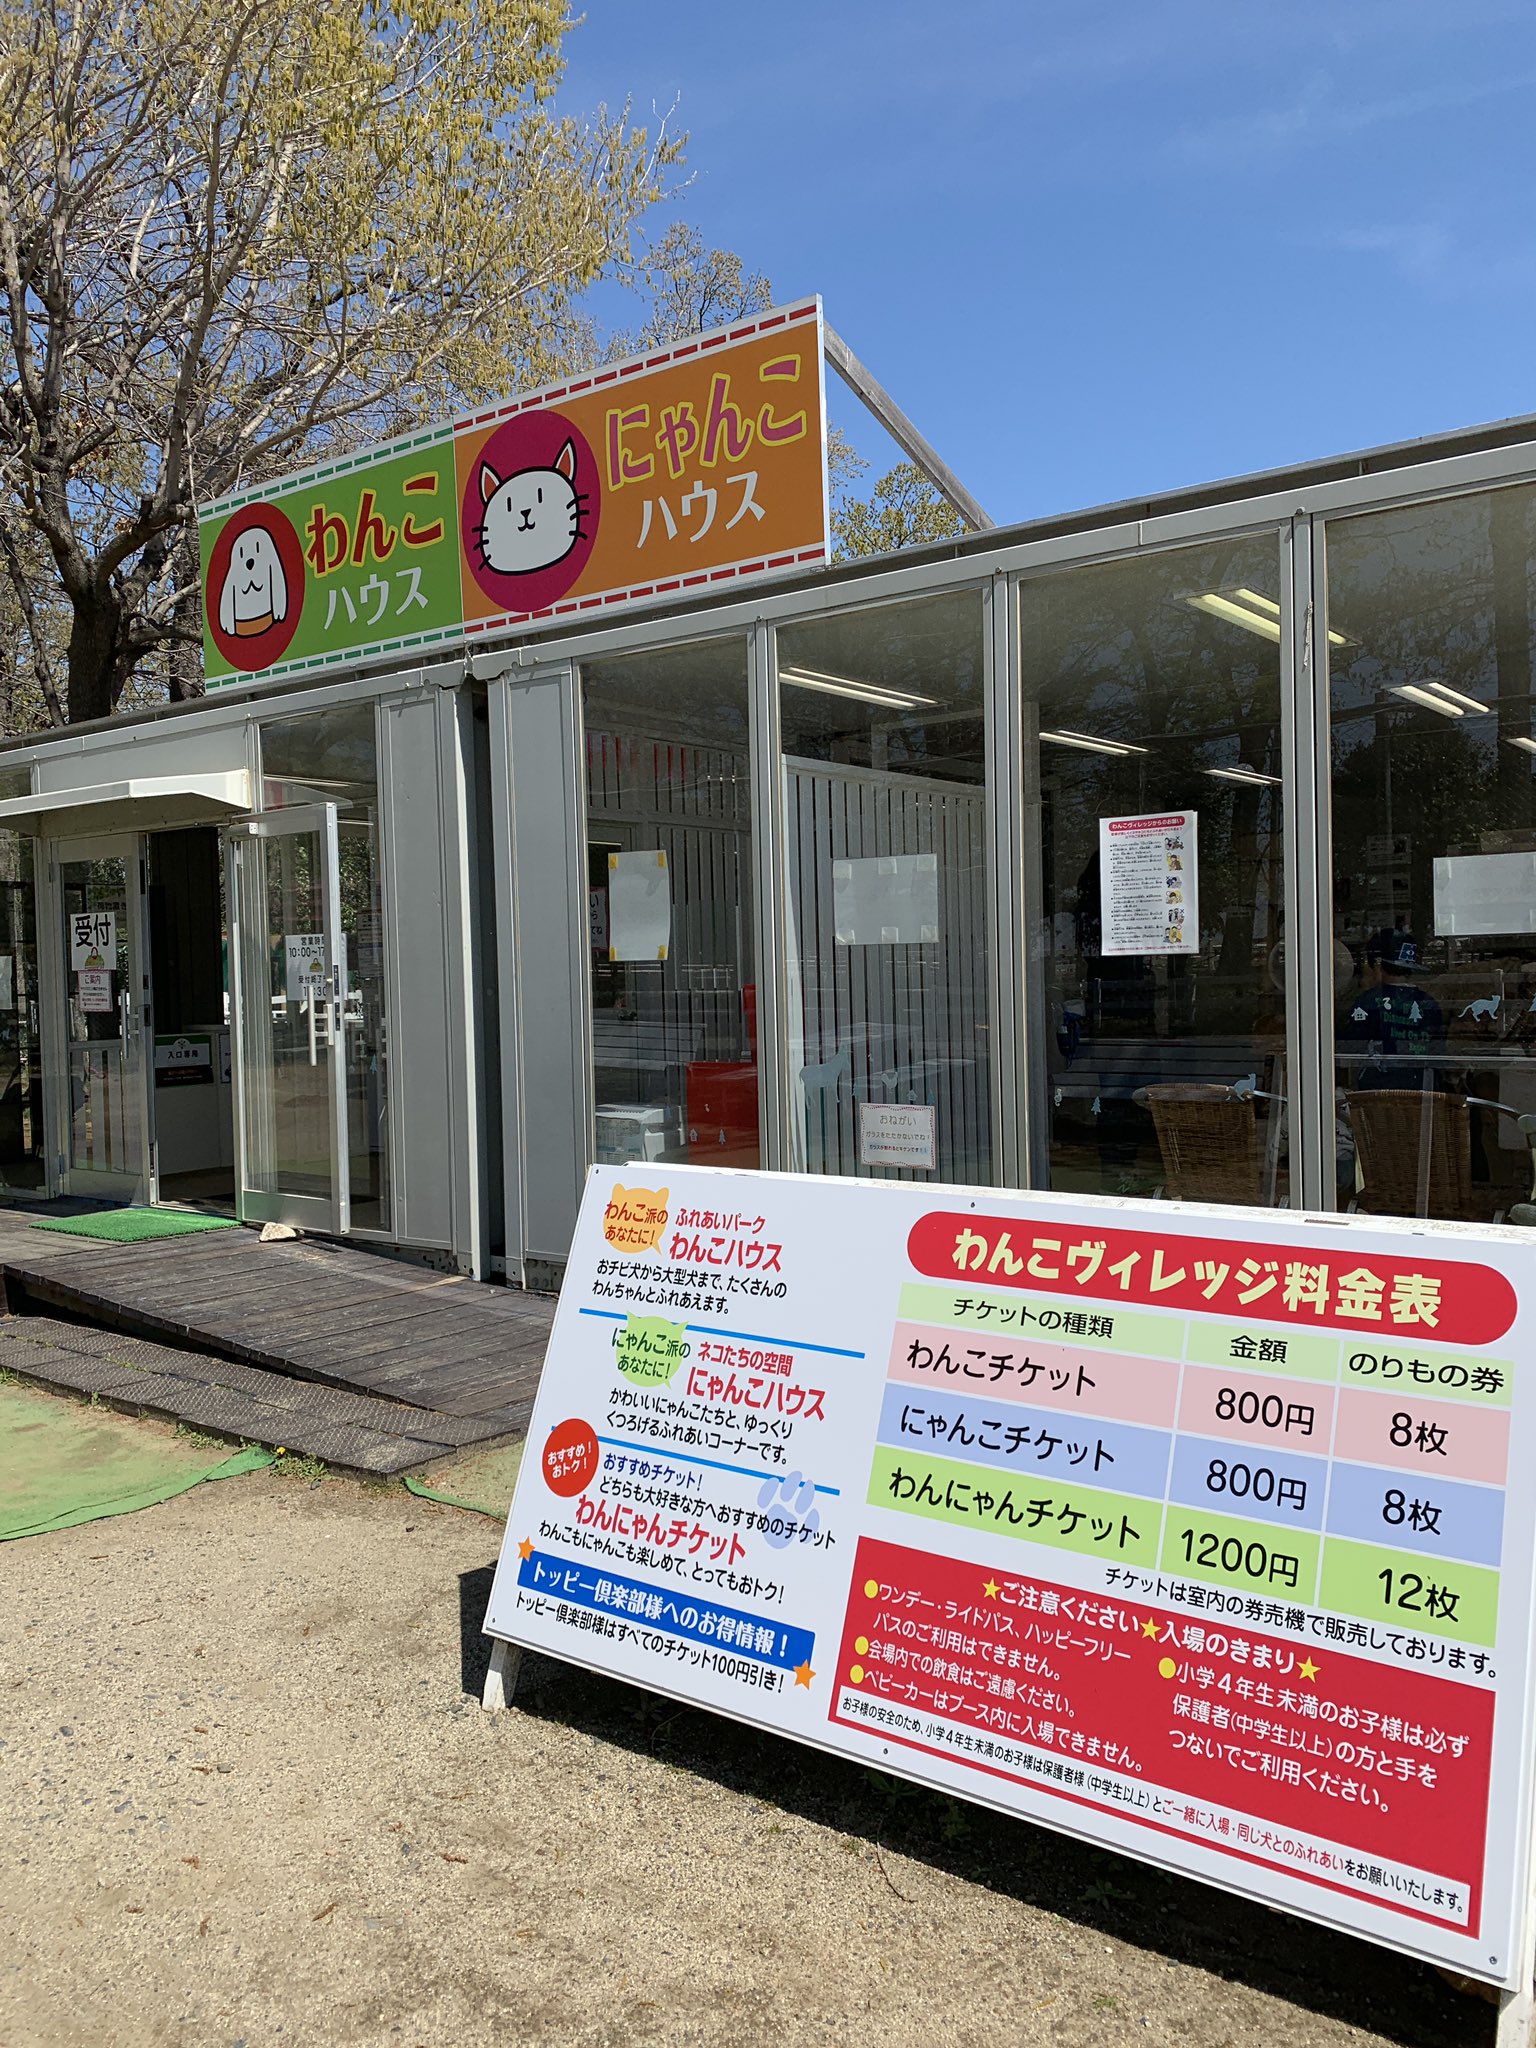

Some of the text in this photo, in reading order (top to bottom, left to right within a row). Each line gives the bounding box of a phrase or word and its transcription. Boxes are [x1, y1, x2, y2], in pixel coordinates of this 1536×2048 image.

[606, 353, 808, 492] にゃんこ
[304, 471, 446, 578] わんこ
[638, 470, 767, 549] ハウス
[323, 565, 429, 631] ハウス
[75, 914, 111, 947] 受付
[301, 936, 324, 946] 営業時
[880, 1115, 917, 1126] おねがい
[604, 1200, 668, 1225] わんこ派の
[604, 1225, 656, 1245] あなたに!
[675, 1208, 766, 1235] ふれあいパーク
[597, 1258, 788, 1299] おチビ犬から大型犬まで、たくさんの
[669, 1232, 783, 1273] わんこハウス
[952, 1228, 1442, 1328] わんこヴィレッジ料金表
[592, 1280, 729, 1315] わんちゃんとふれあえます。
[953, 1298, 1115, 1339] チケットの種類
[611, 1327, 691, 1359] にゃんこ派の
[617, 1355, 671, 1380] あなたに!
[697, 1342, 793, 1377] ネコたちの空間
[907, 1339, 1096, 1397] わんこチケット
[1229, 1334, 1288, 1365] 金額
[686, 1366, 826, 1420] にゃんこハウス
[1348, 1352, 1505, 1395] のりもの券
[606, 1411, 789, 1466] くつろげるふれあいコーナーです。
[609, 1388, 794, 1440] かわいいにゃんこたちと、ゆっくり
[900, 1404, 1115, 1471] にゃんこチケット
[1214, 1387, 1315, 1436] 800円
[1388, 1412, 1449, 1456] 8枚
[547, 1441, 593, 1466] おすすめ!
[552, 1457, 588, 1479] おトク!
[603, 1452, 703, 1491] おすすめチケット!
[888, 1466, 1141, 1549] わんにゃんチケット
[1206, 1458, 1308, 1511] 800円
[574, 1495, 747, 1566] わんにゃんチケット
[599, 1474, 836, 1550] どちらも大好きな方へおすすめのチケット
[1382, 1488, 1443, 1536] 8枚
[538, 1519, 785, 1605] わんこもにゃんこも楽しめて、とってもおトク!
[1180, 1528, 1299, 1588] 1200円
[533, 1560, 788, 1658] トッピー倶楽部様へのお得情報!
[878, 1583, 1132, 1662] ワンデー・ライドパス、ハッピーフリー
[999, 1580, 1139, 1634] ご注意ください
[1377, 1568, 1461, 1623] 12枚
[515, 1590, 785, 1694] トッピー倶楽部様はすべてのチケット100円引き!
[873, 1612, 1062, 1681] パスのご利用はできません。
[1105, 1567, 1498, 1679] チケットは室内の券売機で販売しております。
[1158, 1620, 1296, 1676] 入場のきまり
[868, 1640, 1076, 1718] 会場内での飲食はご遠慮ください。
[864, 1670, 1144, 1773] ベビーカーはブース内に入場できません。
[1176, 1660, 1469, 1760] 小学4年生未満のお子様は必ず
[1171, 1693, 1439, 1790] 保護者(中学生以上)の方と手を
[1168, 1728, 1390, 1813] つないでご利用ください。
